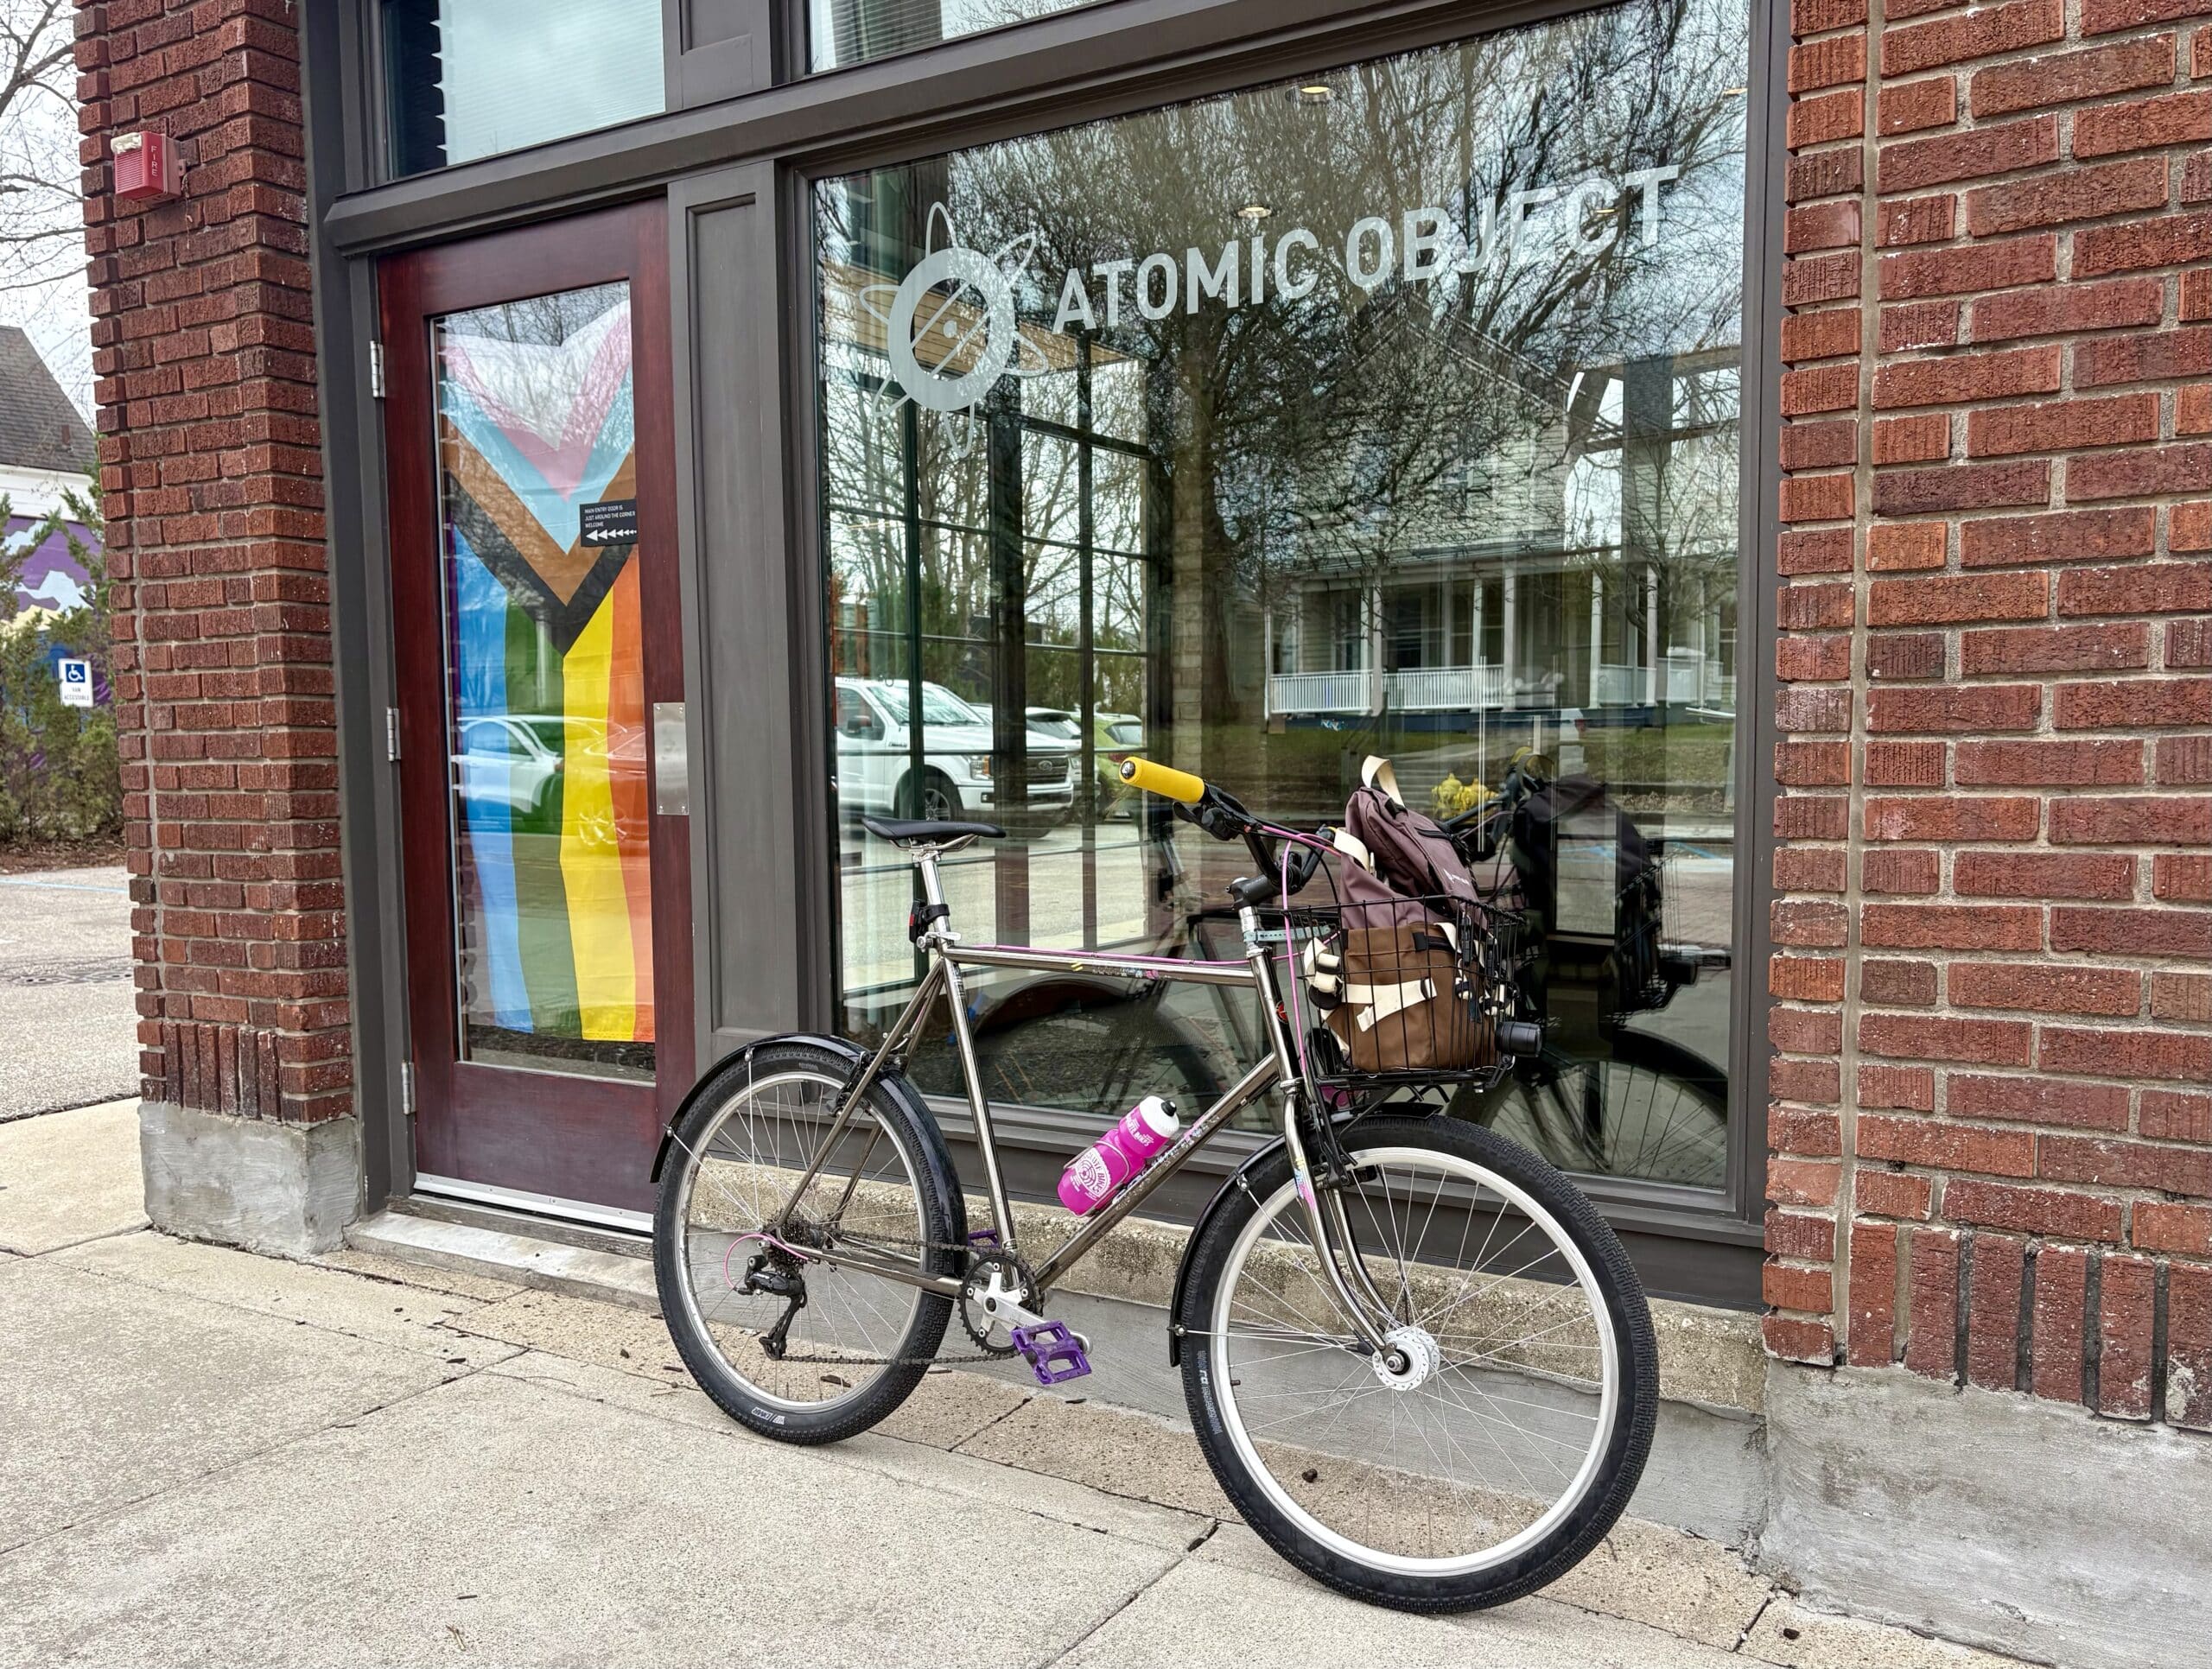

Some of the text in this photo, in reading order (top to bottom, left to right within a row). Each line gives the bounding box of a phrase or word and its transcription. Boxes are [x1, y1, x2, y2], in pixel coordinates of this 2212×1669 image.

[1052, 165, 1680, 335] ATOMIC OBJECT
[1092, 1172, 1106, 1193] BIKES
